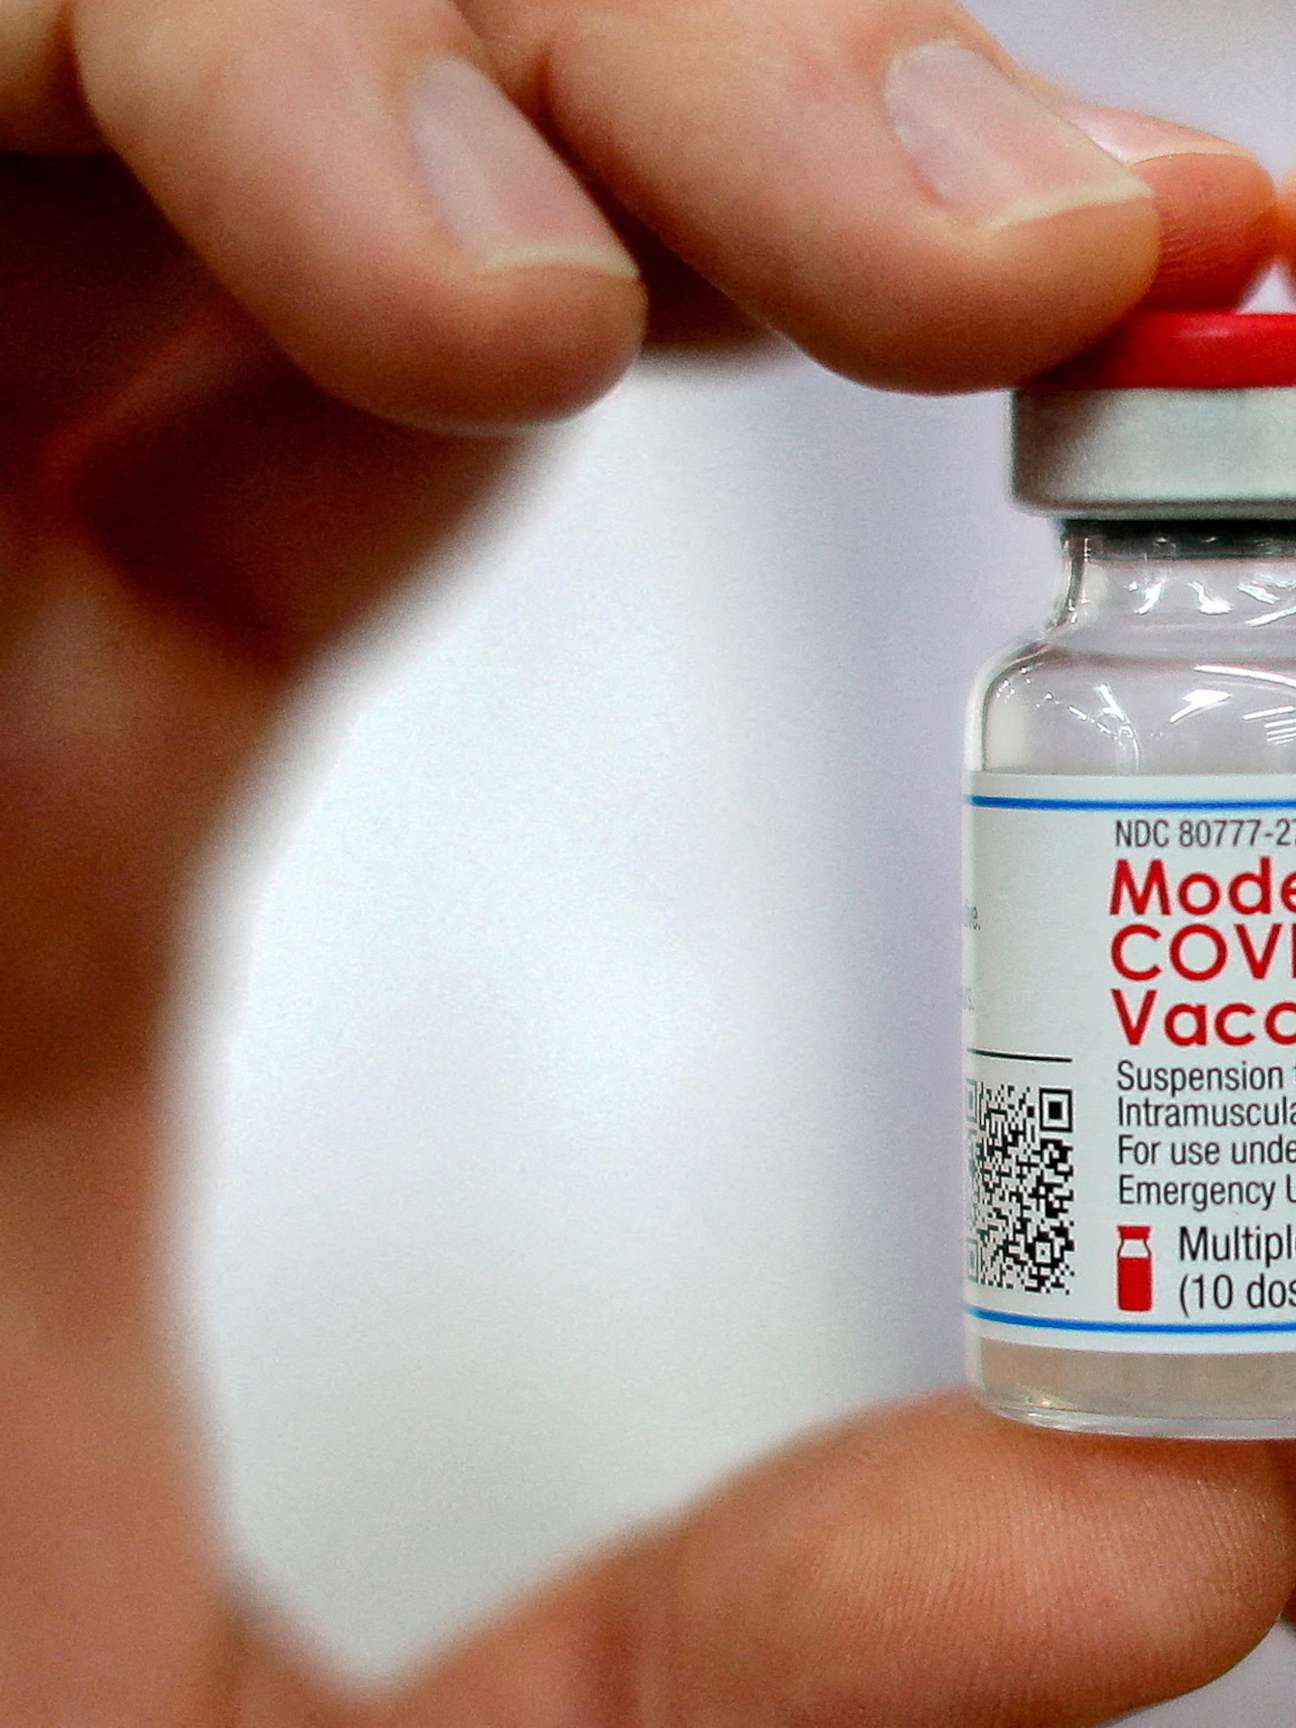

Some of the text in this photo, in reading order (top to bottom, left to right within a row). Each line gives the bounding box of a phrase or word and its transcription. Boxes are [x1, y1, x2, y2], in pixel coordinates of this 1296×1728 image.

[1115, 820, 1169, 847] NDC
[1117, 1060, 1282, 1097] Suspension
[1118, 1135, 1160, 1165] For
[1170, 1142, 1219, 1164] use
[1119, 1176, 1275, 1212] Emergency
[1179, 1274, 1232, 1317] (10
